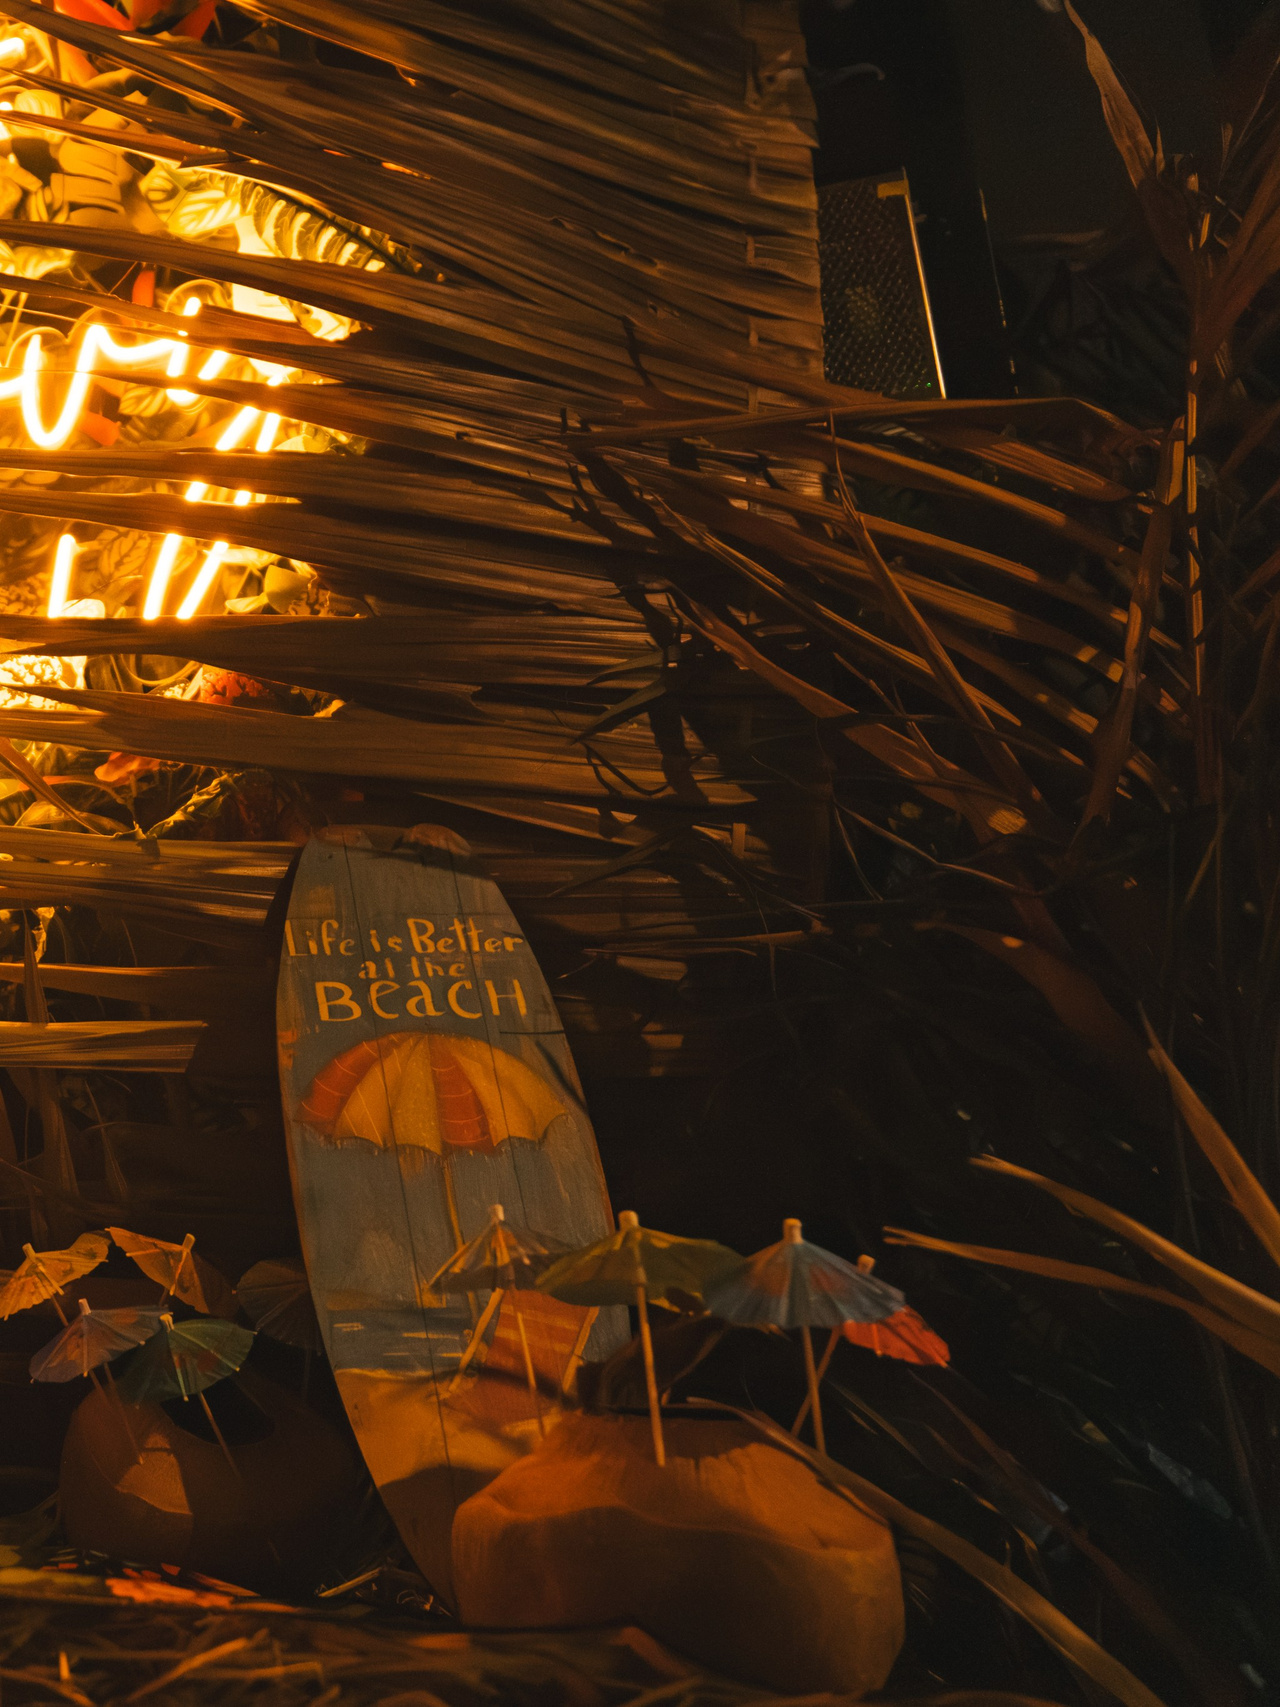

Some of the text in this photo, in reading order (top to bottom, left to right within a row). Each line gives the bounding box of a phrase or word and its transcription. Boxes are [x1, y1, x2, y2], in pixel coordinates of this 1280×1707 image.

[285, 918, 356, 957] Life
[406, 917, 523, 954] Better
[410, 955, 467, 979] the
